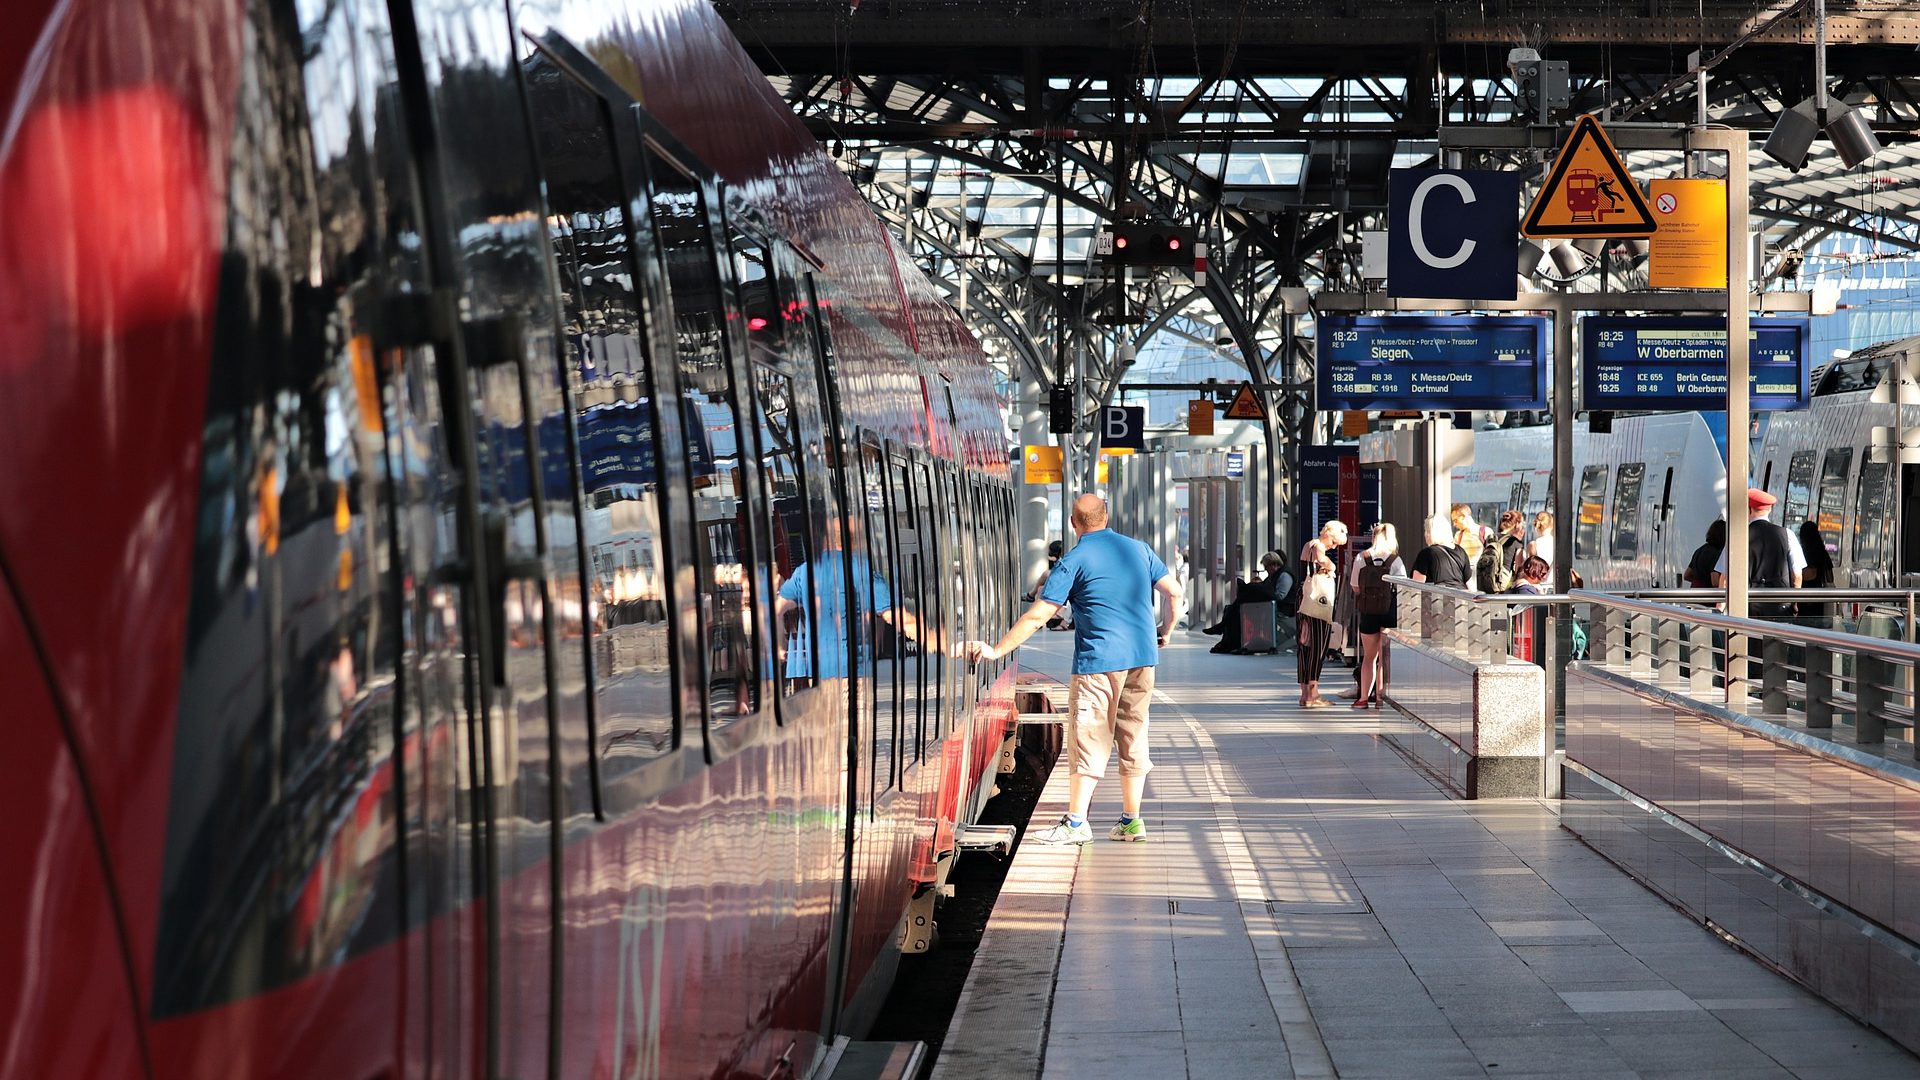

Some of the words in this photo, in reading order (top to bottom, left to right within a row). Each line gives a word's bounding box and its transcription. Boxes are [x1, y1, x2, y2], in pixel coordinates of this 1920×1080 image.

[1408, 173, 1477, 270] C
[1332, 331, 1358, 341] 18:23
[1598, 331, 1624, 341] 18:25
[1686, 339, 1709, 347] Opladen
[1371, 346, 1408, 361] Siegen
[1637, 346, 1651, 358] W
[1654, 346, 1724, 358] Oberbarmen
[1332, 373, 1354, 381] 18:28
[1371, 373, 1382, 381] RB
[1383, 373, 1393, 381] 38
[1411, 373, 1418, 381] K
[1420, 373, 1473, 381] Messe/Deutz
[1597, 373, 1620, 381] 18:48
[1637, 373, 1648, 381] ICE
[1650, 373, 1663, 381] 655
[1676, 373, 1699, 381] Berlin
[1332, 384, 1354, 392] 18:46
[1381, 384, 1398, 392] 1918
[1411, 384, 1449, 392] Dortmund
[1597, 384, 1620, 392] 19:25
[1637, 384, 1647, 392] RB
[1649, 384, 1658, 392] 48
[1676, 384, 1685, 392] W
[1688, 384, 1727, 392] Oberbarm
[1106, 407, 1129, 439] B
